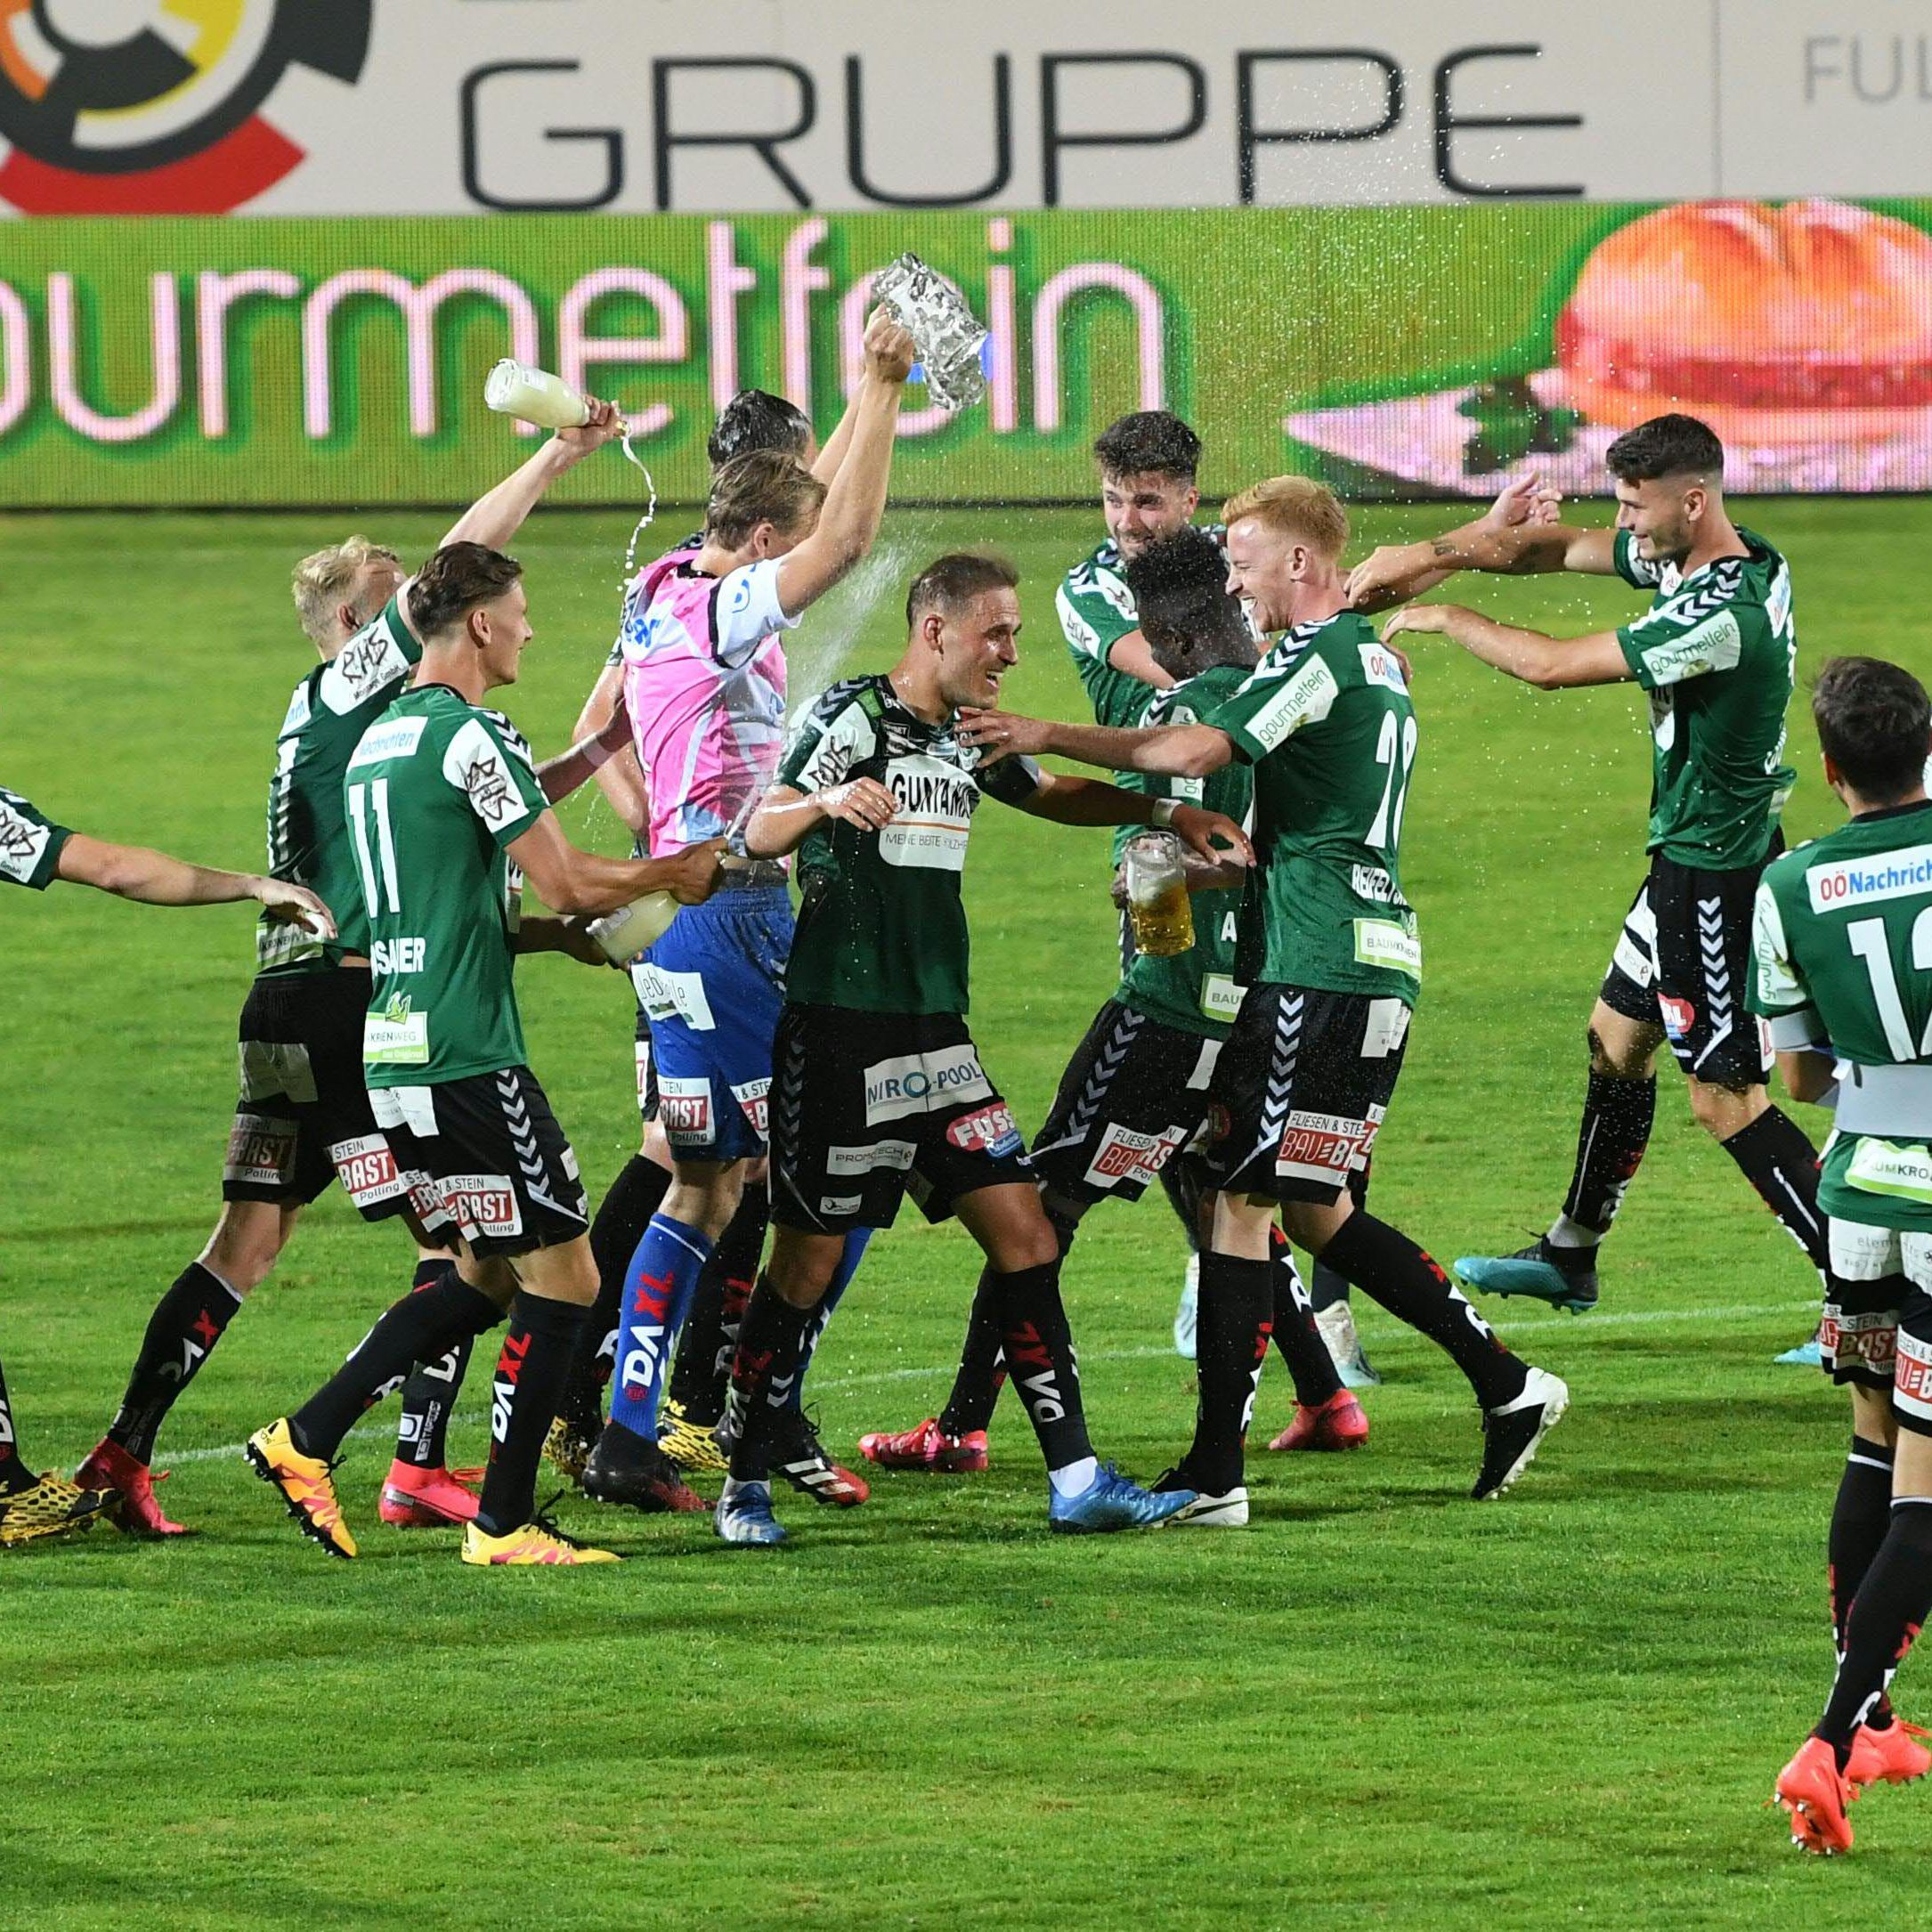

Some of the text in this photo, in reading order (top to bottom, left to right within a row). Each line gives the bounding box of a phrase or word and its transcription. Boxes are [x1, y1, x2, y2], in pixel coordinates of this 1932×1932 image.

[459, 43, 1585, 212] GRUPPE
[0, 216, 1165, 442] urmetfin
[348, 777, 401, 919] 11
[1212, 992, 1244, 1005] BAU
[867, 1061, 982, 1106] NIRO-POOL
[334, 1141, 365, 1159] STEIN
[337, 1151, 389, 1192] BAST
[360, 1182, 400, 1202] Polling
[455, 1177, 484, 1189] STEIN
[622, 1270, 674, 1390] DAXL
[491, 1332, 532, 1444] DAXL
